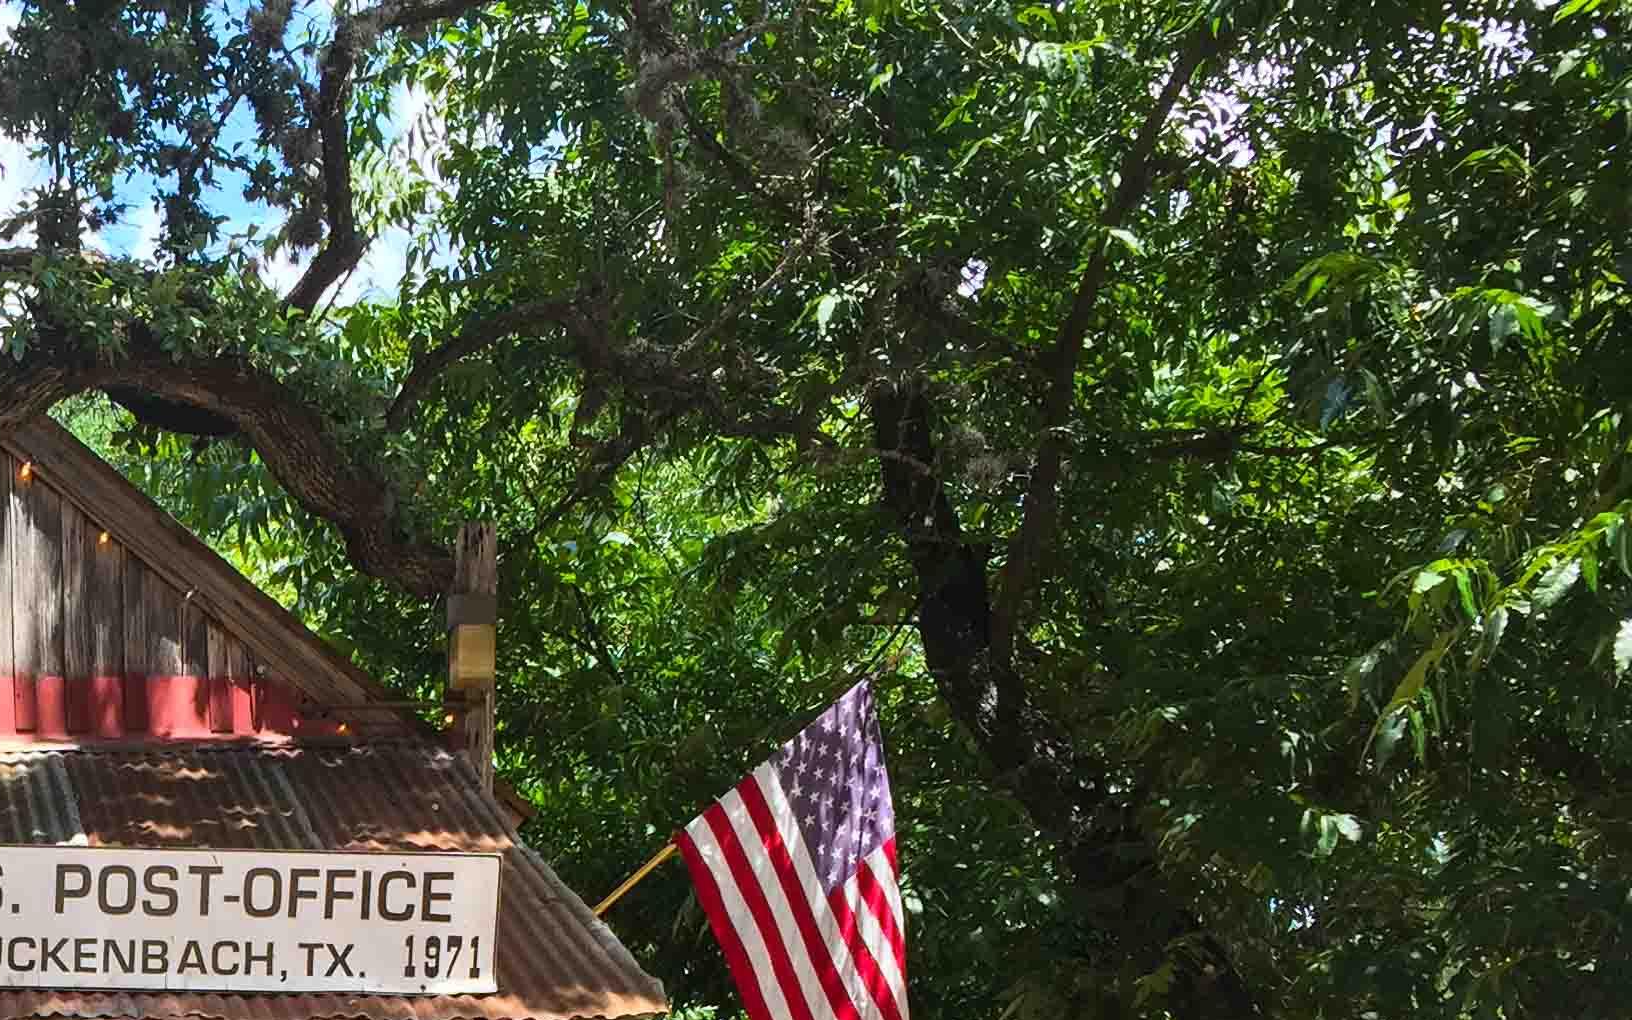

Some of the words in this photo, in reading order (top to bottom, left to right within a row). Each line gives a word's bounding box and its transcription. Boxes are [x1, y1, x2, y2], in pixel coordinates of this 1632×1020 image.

[54, 863, 455, 923] POST-OFFICE
[298, 942, 366, 979] TX.
[403, 935, 482, 980] 1971
